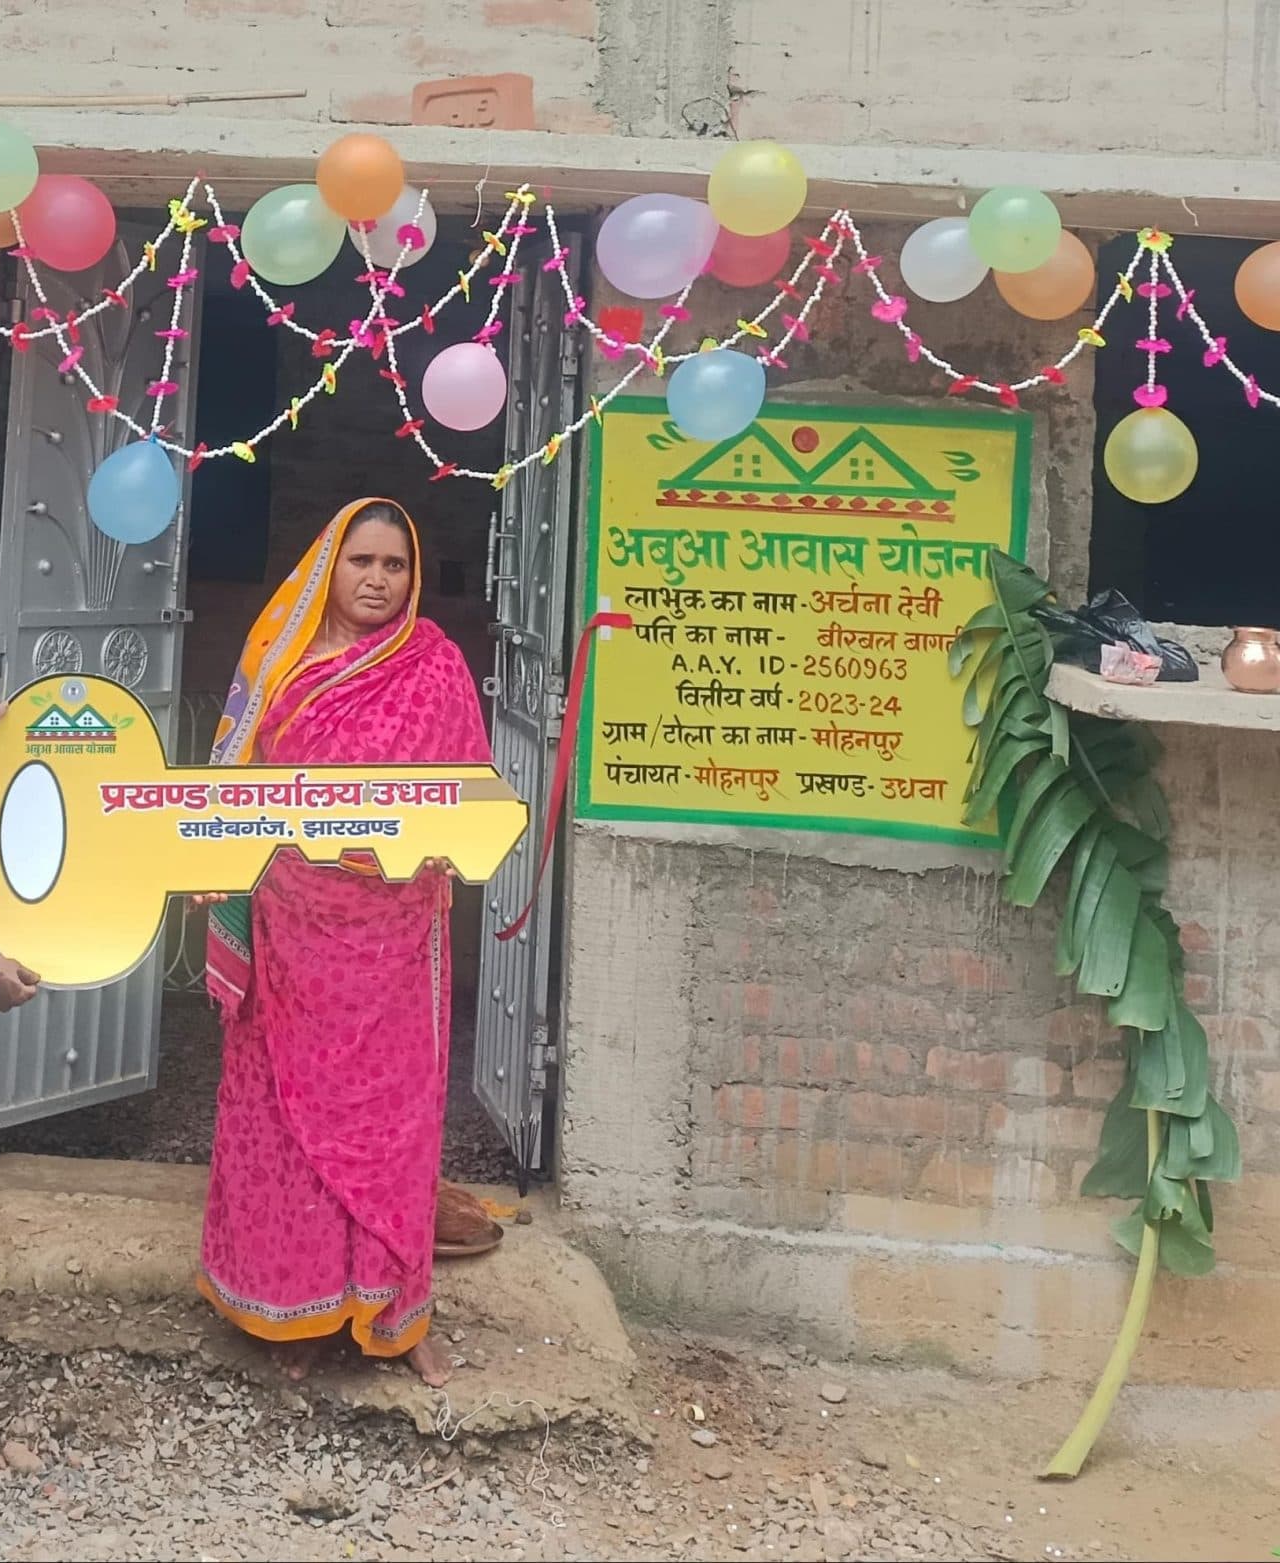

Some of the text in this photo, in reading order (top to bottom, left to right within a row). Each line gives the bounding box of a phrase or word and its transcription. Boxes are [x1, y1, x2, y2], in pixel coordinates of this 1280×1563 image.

[607, 522, 1000, 586] अबुआ आवास योजना
[624, 586, 706, 620] लाभुक
[709, 590, 746, 612] का
[809, 582, 892, 615] अर्चना
[897, 586, 944, 619] देवी
[632, 615, 677, 649] पति
[685, 625, 717, 645] का
[816, 621, 899, 652] बीरबल
[803, 654, 908, 681] 2560963
[675, 678, 745, 715] वित्तीय
[798, 689, 902, 717] 2023-24
[721, 726, 751, 746] का
[810, 719, 904, 762] मोहनपुर
[99, 772, 460, 814] प्रखण्ड कार्यालय उधवा
[693, 756, 782, 801] मोहनपुर
[879, 776, 949, 801] उधवा
[301, 819, 401, 838] झारखण्ड
